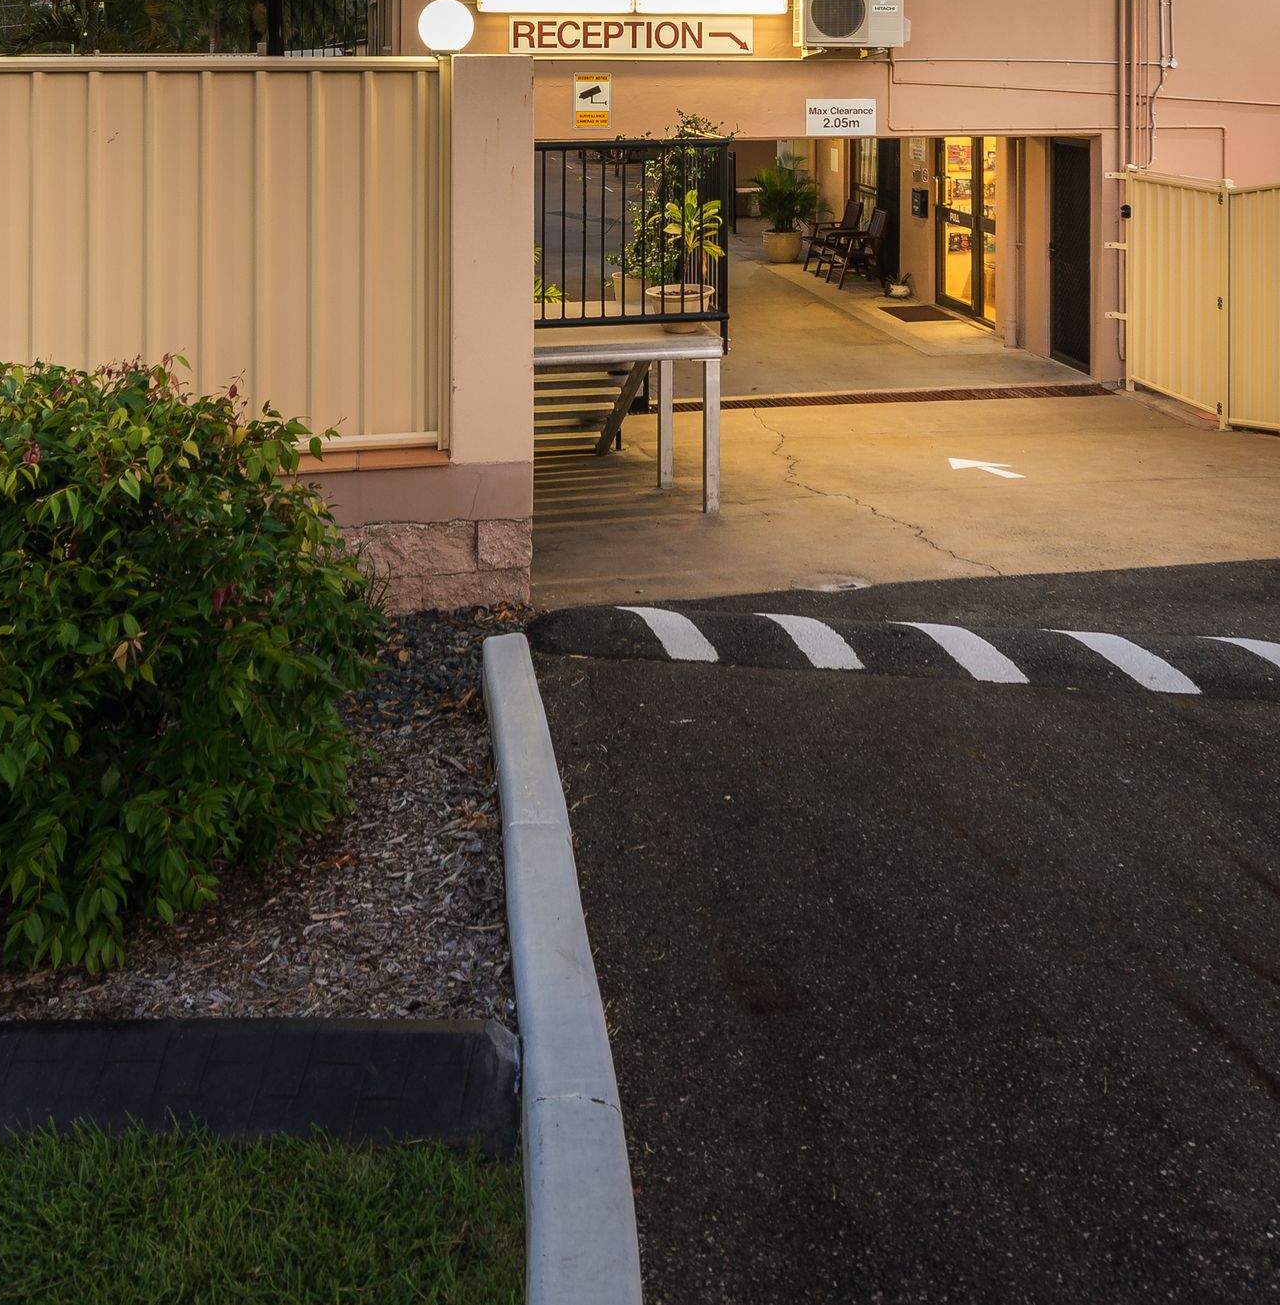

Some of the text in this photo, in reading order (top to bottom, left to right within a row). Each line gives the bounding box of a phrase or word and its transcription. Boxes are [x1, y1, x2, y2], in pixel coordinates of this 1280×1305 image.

[512, 20, 704, 50] RECEPTION
[808, 106, 874, 115] Max Clearance
[823, 117, 860, 128] 2.05m
[949, 212, 960, 223] PULL
